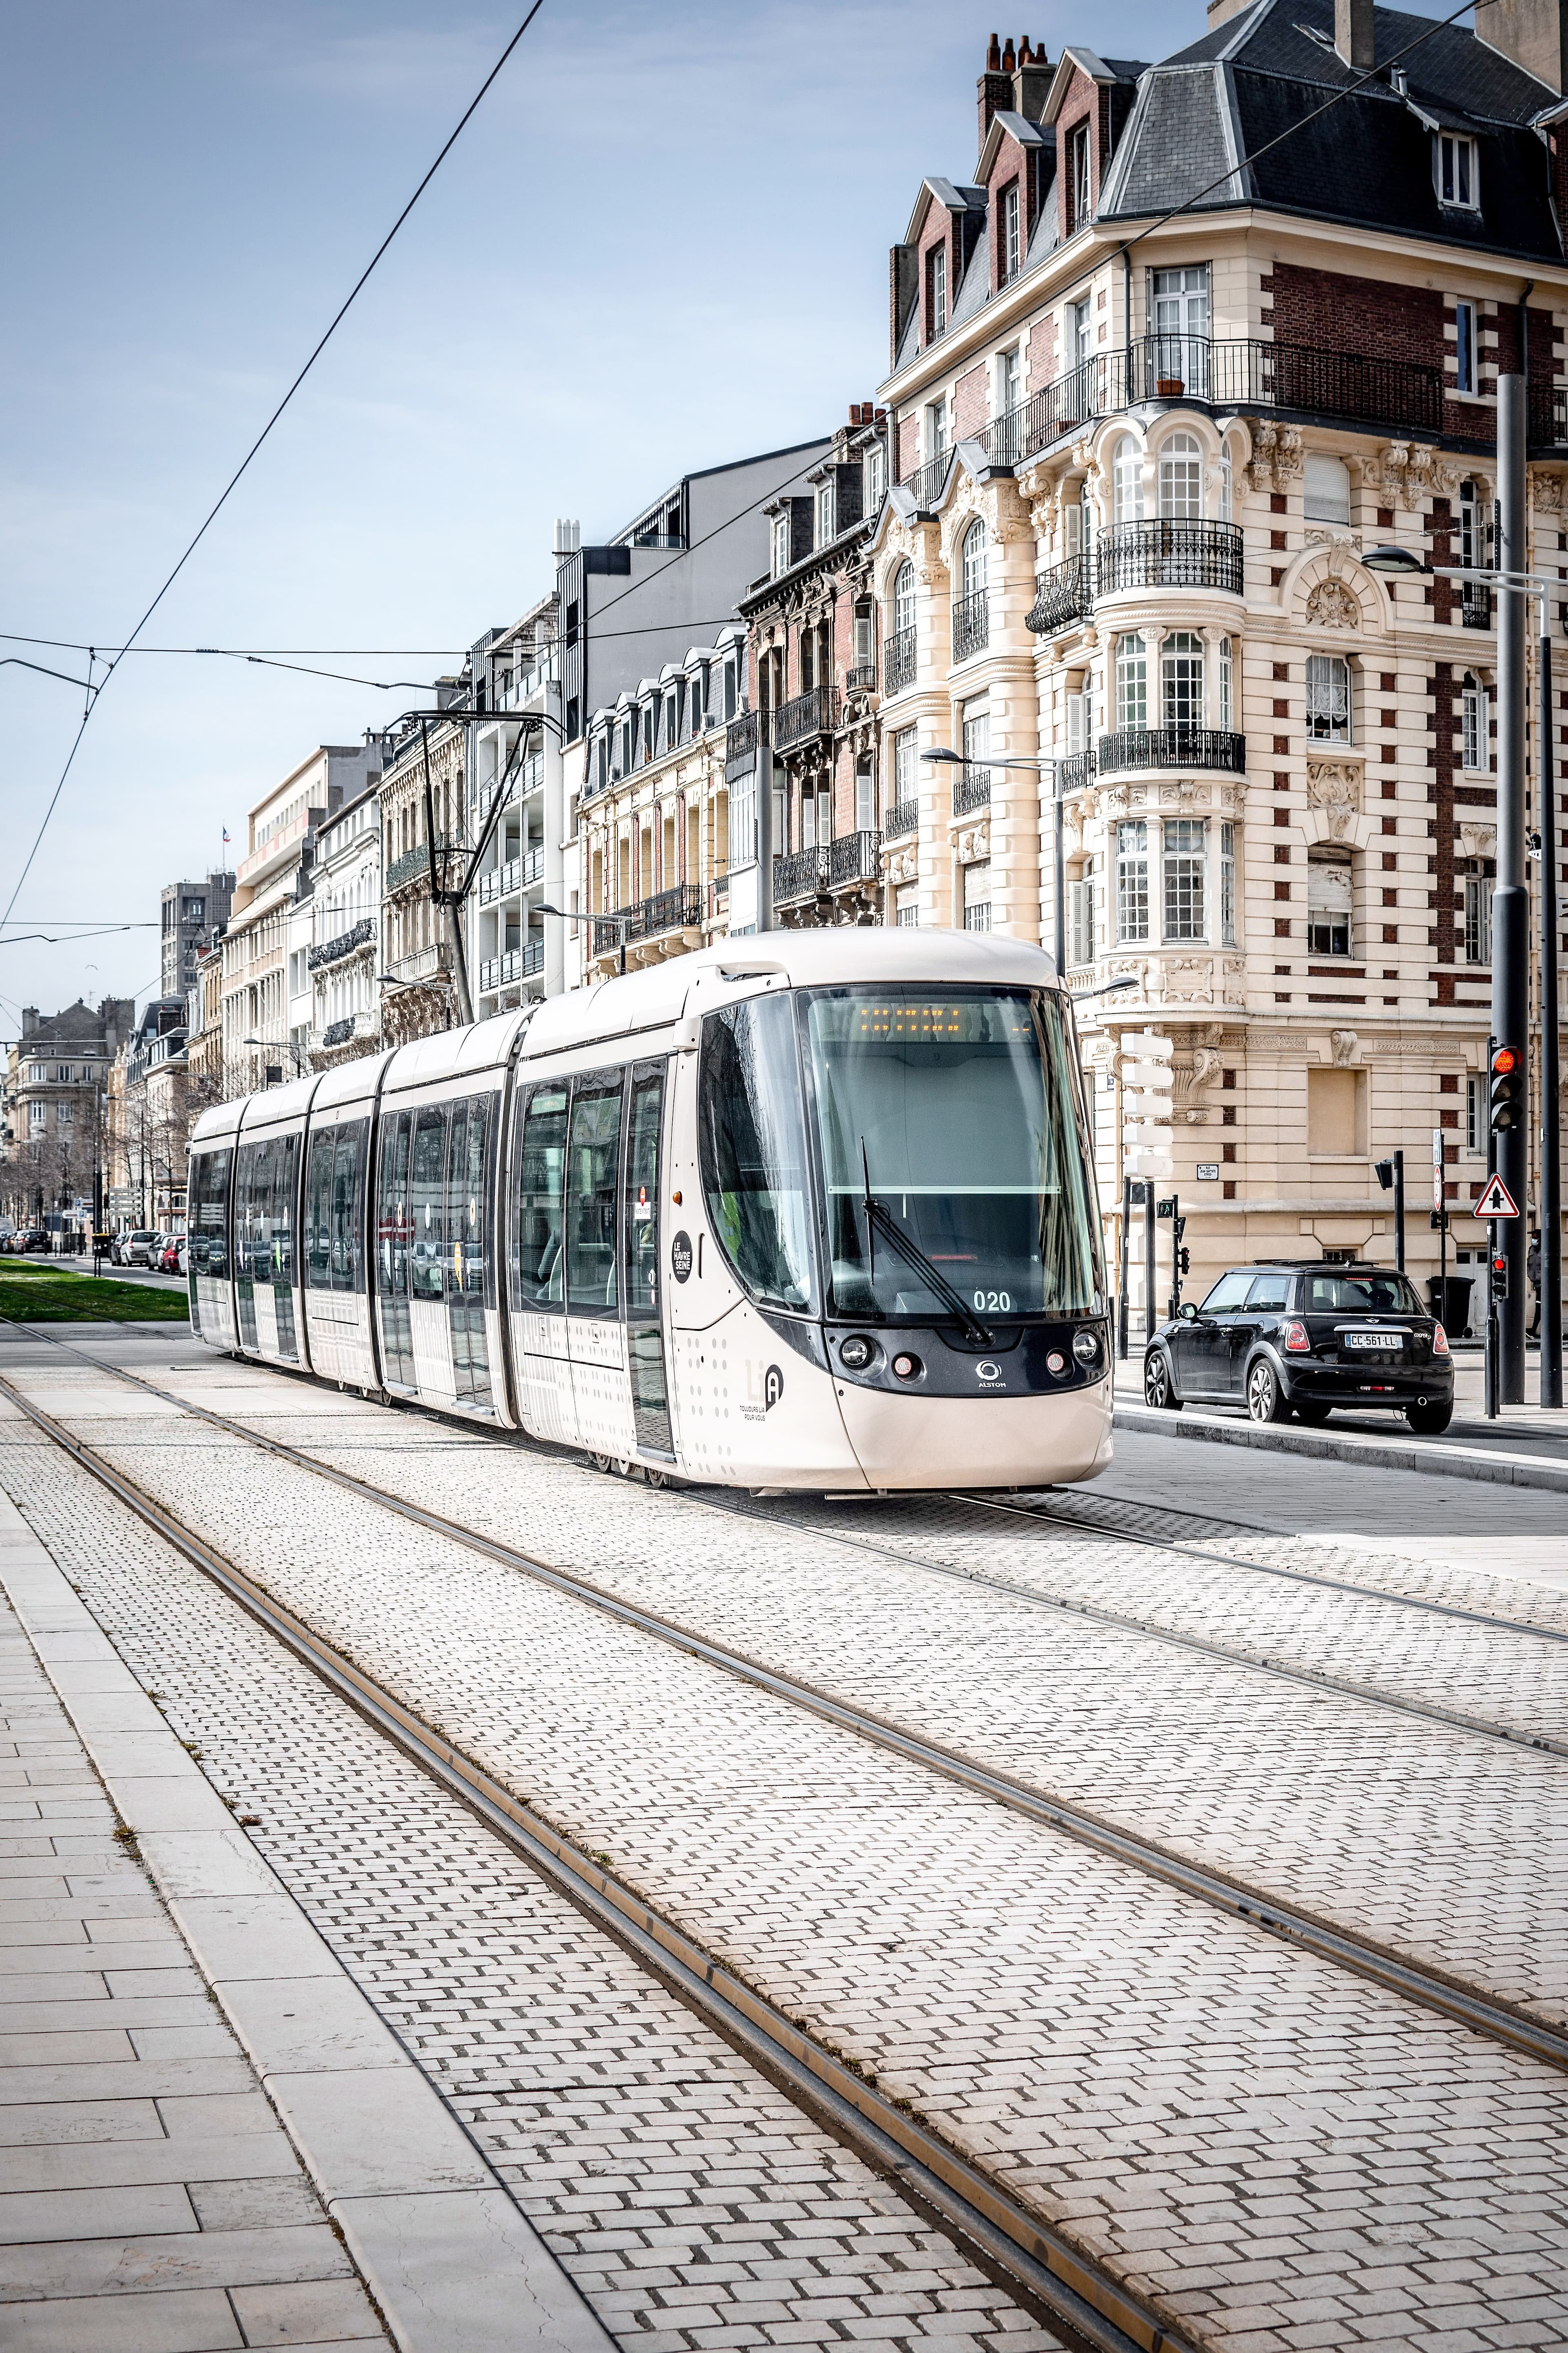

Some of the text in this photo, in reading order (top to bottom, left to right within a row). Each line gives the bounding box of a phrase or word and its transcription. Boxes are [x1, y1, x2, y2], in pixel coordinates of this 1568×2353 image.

[674, 1242, 680, 1251] LE
[674, 1251, 690, 1260] HAVRE
[675, 1261, 690, 1270] SEINE
[974, 1291, 1010, 1311] 020
